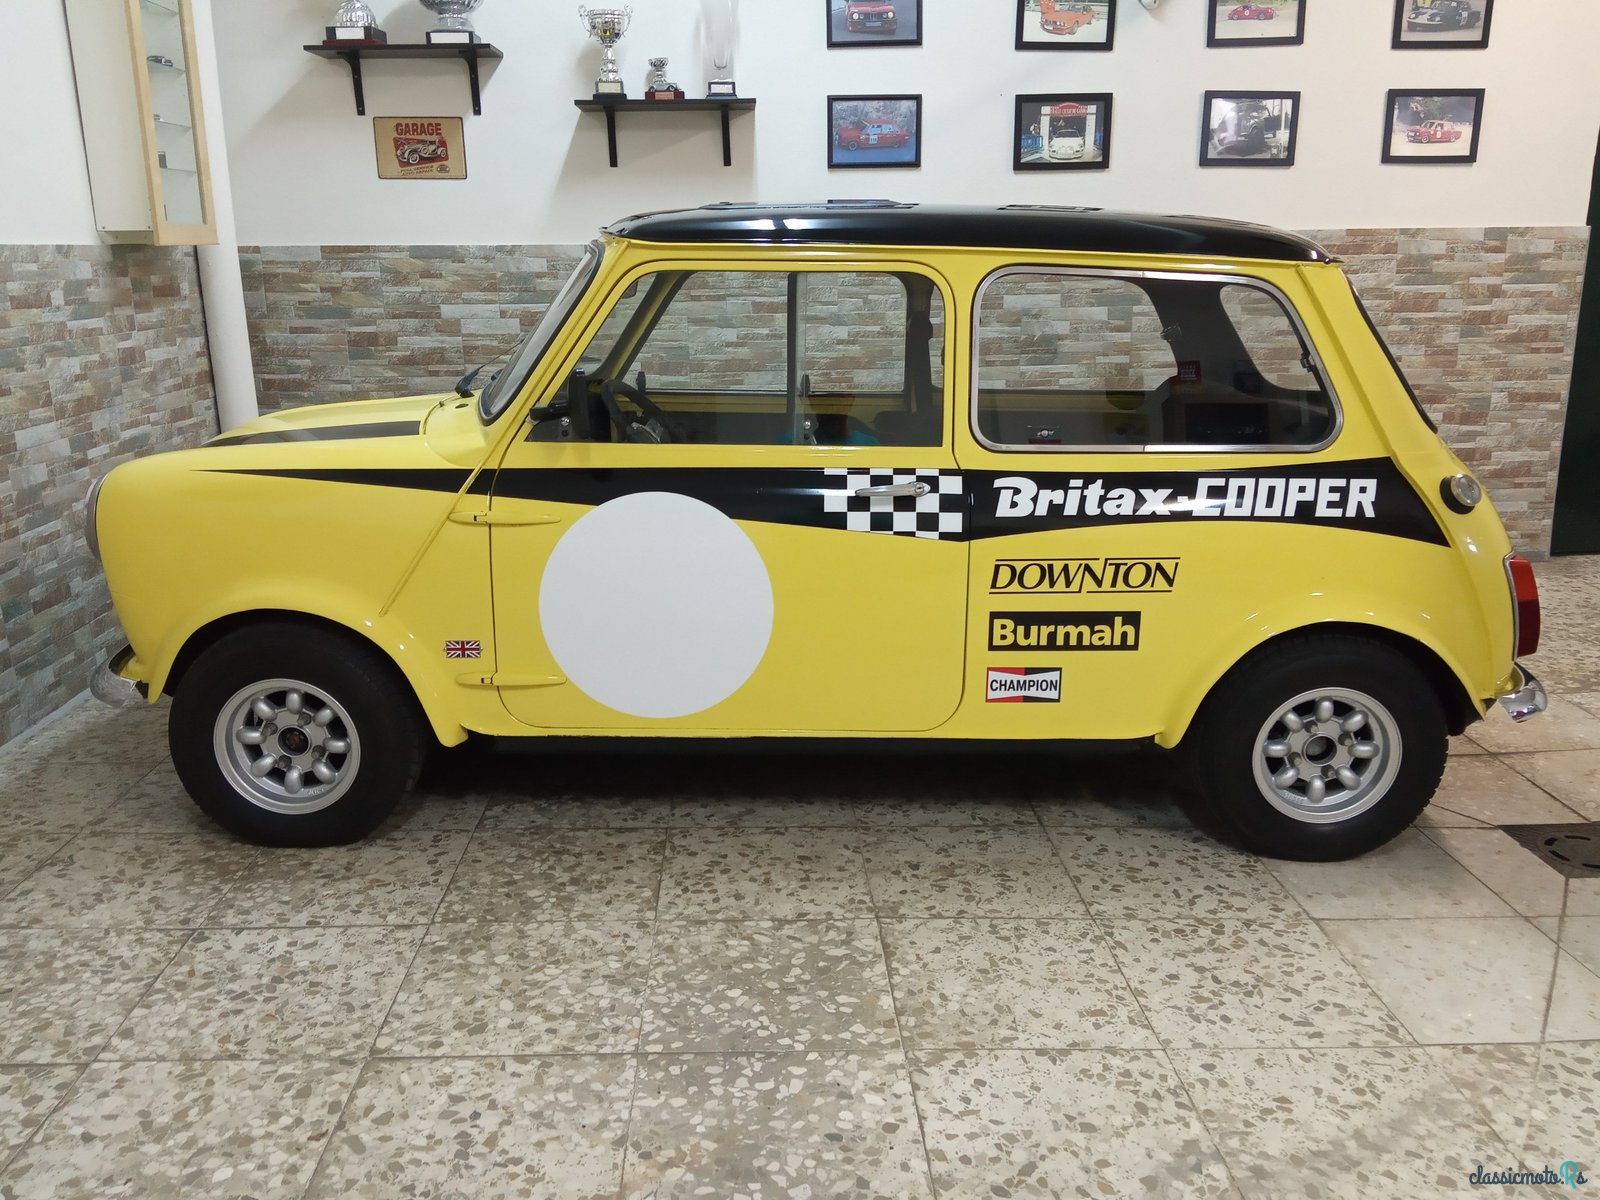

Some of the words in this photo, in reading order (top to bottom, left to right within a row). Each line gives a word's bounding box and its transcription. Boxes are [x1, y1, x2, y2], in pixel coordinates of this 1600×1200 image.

[395, 122, 442, 136] GARAGE
[989, 557, 1180, 594] DOWNTON
[992, 616, 1136, 646] Burmah
[989, 679, 1059, 692] CHAMPION
